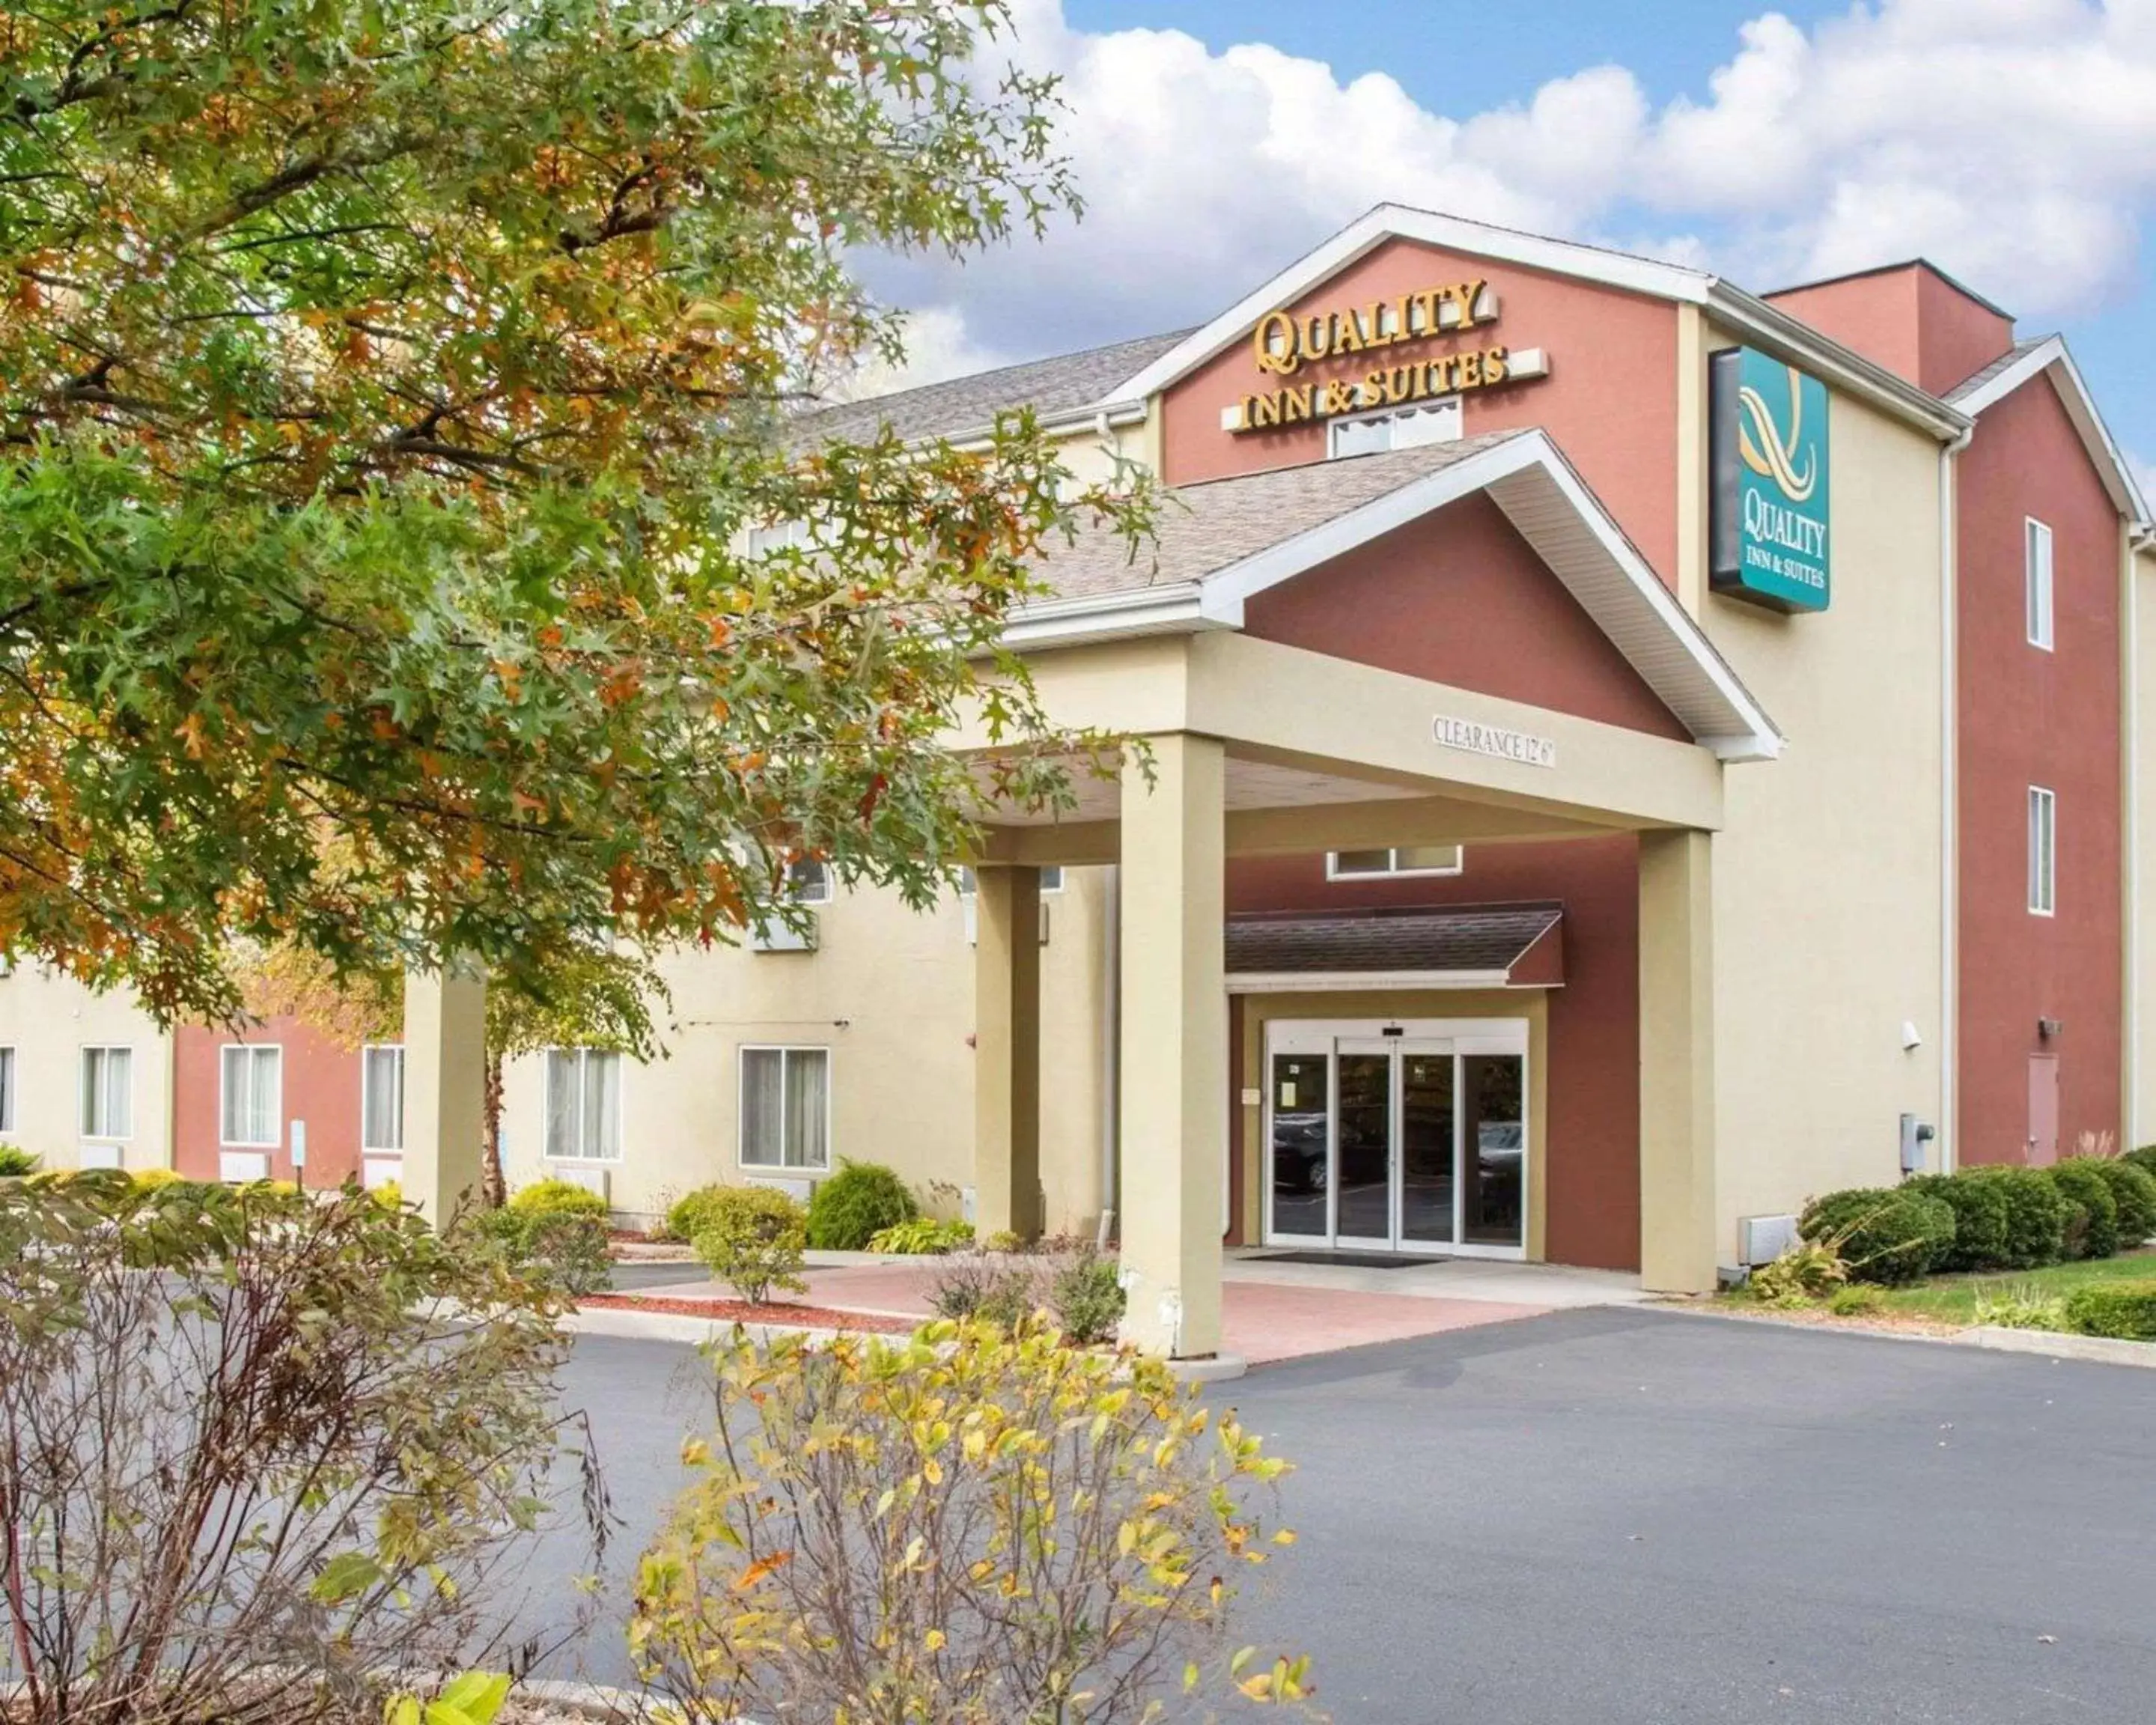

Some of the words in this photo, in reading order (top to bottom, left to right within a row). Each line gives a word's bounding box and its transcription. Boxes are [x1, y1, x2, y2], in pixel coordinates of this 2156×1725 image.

[1254, 279, 1487, 374] QUALITY
[1240, 381, 1314, 429] INN
[1325, 378, 1355, 413] &
[1362, 346, 1508, 407] SUITES
[1744, 488, 1826, 558] QUALITY
[1746, 545, 1770, 569] INN
[1783, 558, 1825, 588] SUITES
[1434, 717, 1521, 758] CLEARANCE
